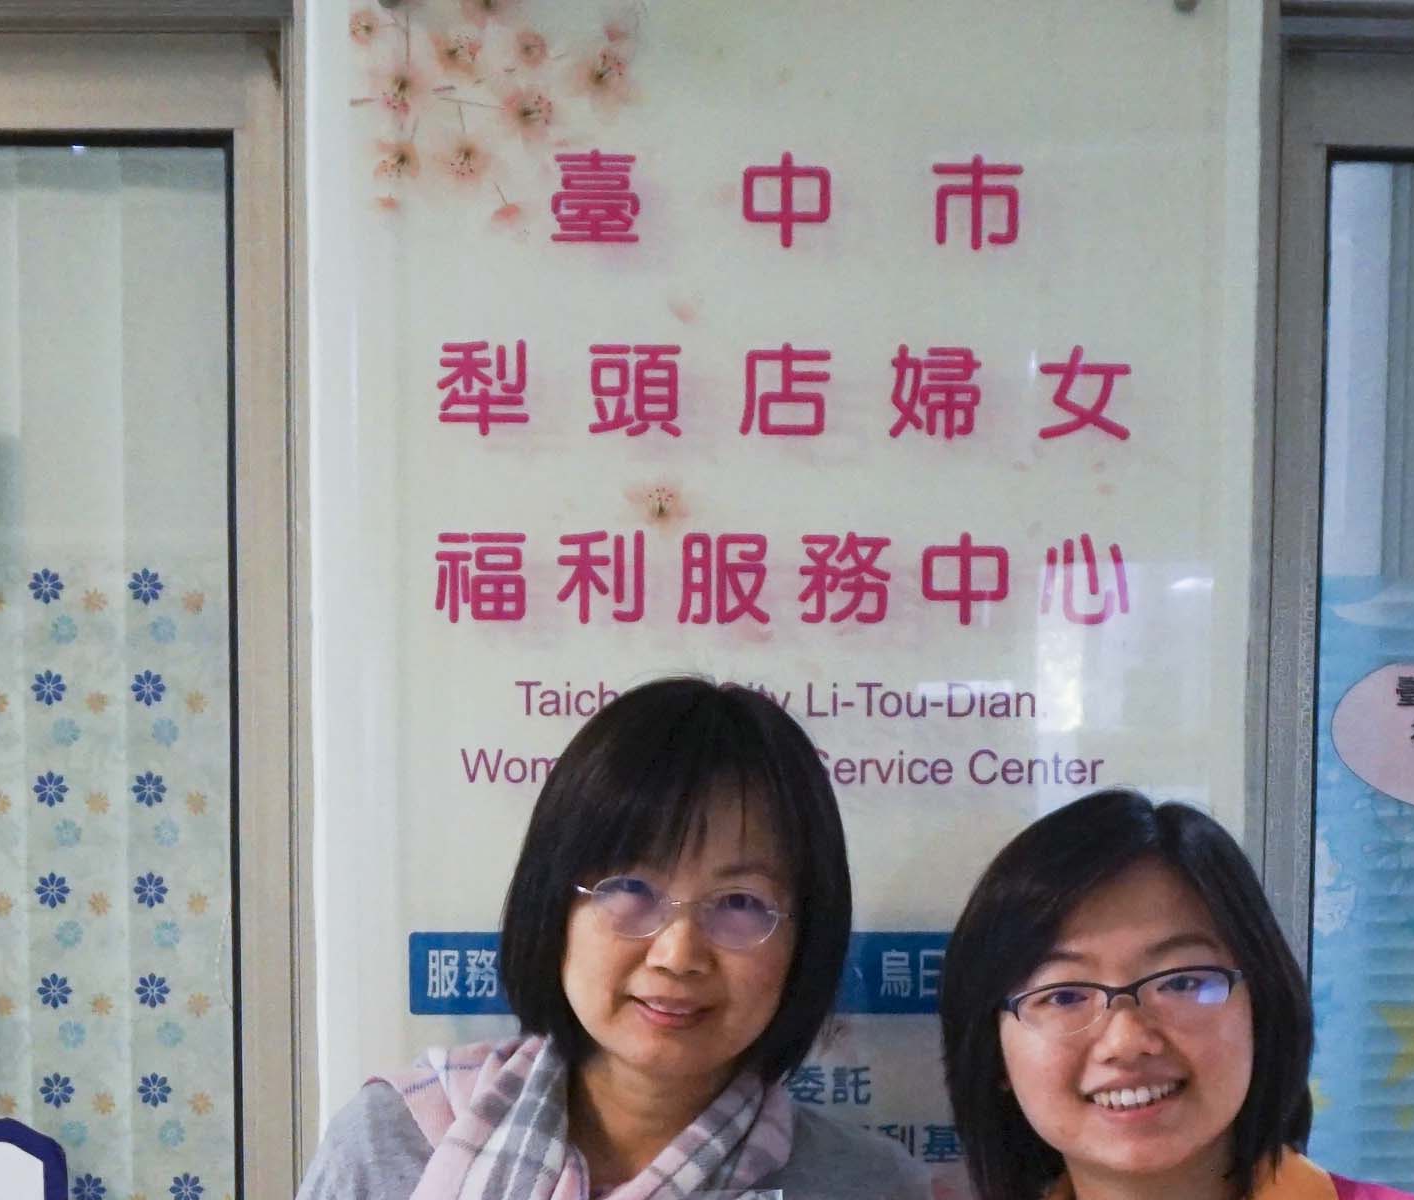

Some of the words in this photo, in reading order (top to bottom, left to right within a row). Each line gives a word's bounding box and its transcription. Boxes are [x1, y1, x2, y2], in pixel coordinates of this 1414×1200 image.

[549, 149, 1025, 250] 臺中市
[436, 338, 1133, 442] 犁頭店婦女
[433, 529, 1132, 628] 福利服務中心
[515, 680, 620, 717] Taich
[806, 682, 1036, 718] Li-Tou-Dian
[968, 748, 1105, 785] Center
[426, 948, 499, 999] 服務
